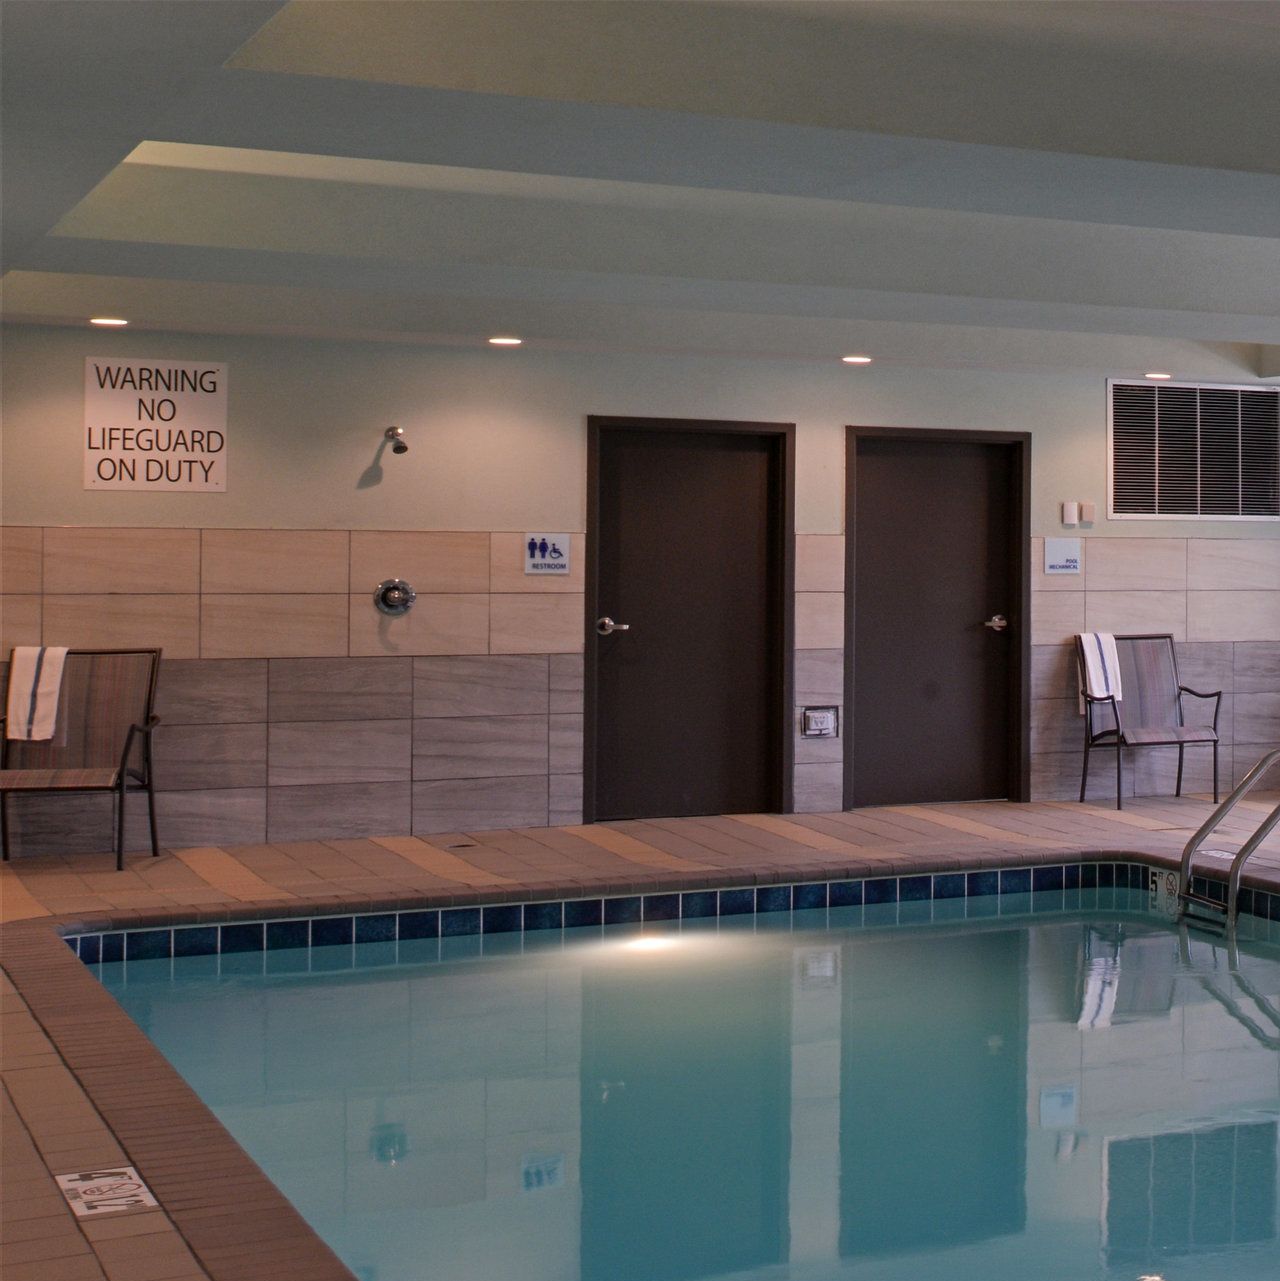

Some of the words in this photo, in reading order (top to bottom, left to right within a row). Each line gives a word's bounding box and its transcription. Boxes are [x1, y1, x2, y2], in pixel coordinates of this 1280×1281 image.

[95, 366, 217, 393] WARNING
[138, 398, 176, 422] NO
[88, 427, 224, 453] LIFEGUARD
[97, 457, 136, 481] ON
[146, 459, 215, 483] DUTY
[1151, 871, 1158, 892] 5
